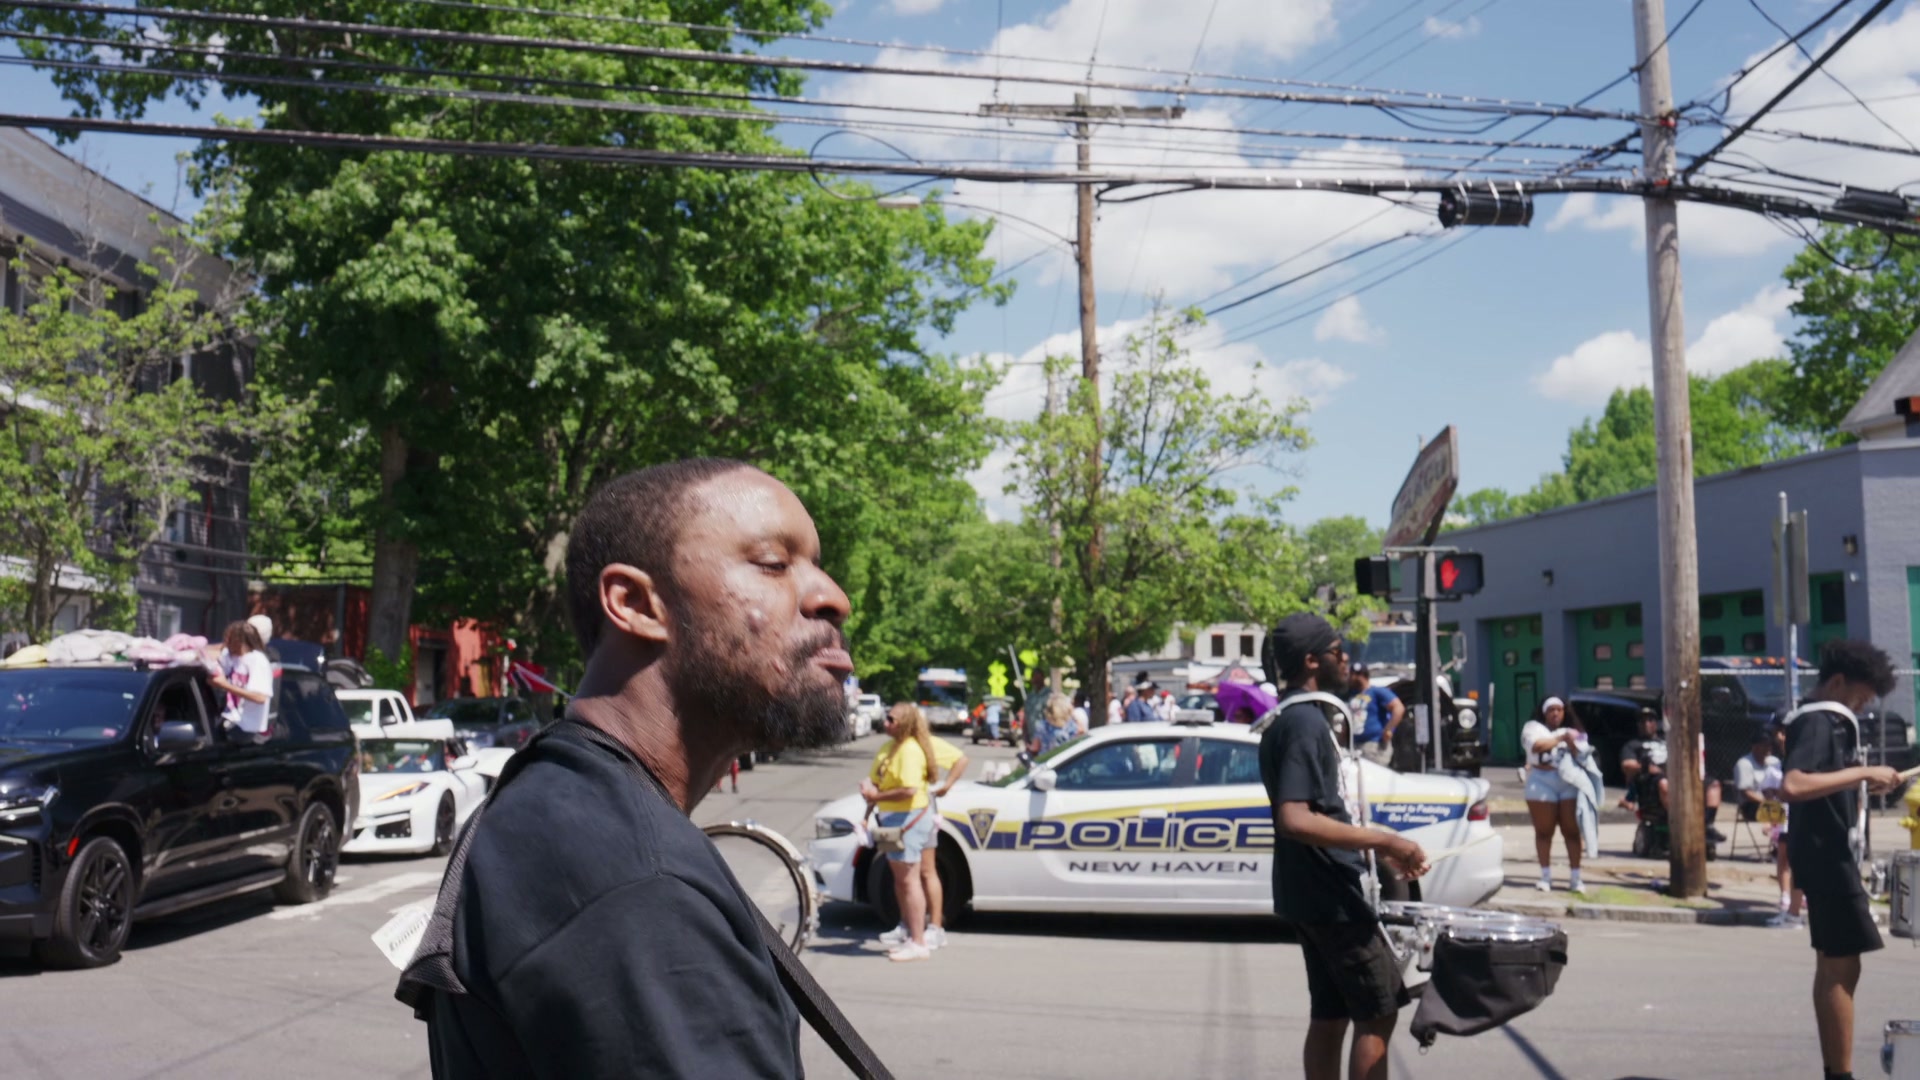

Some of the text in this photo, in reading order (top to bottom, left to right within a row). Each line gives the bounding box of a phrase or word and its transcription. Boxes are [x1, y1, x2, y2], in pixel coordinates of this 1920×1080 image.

[1016, 818, 1275, 850] POLICE
[1069, 861, 1258, 872] NEW HAVEN
